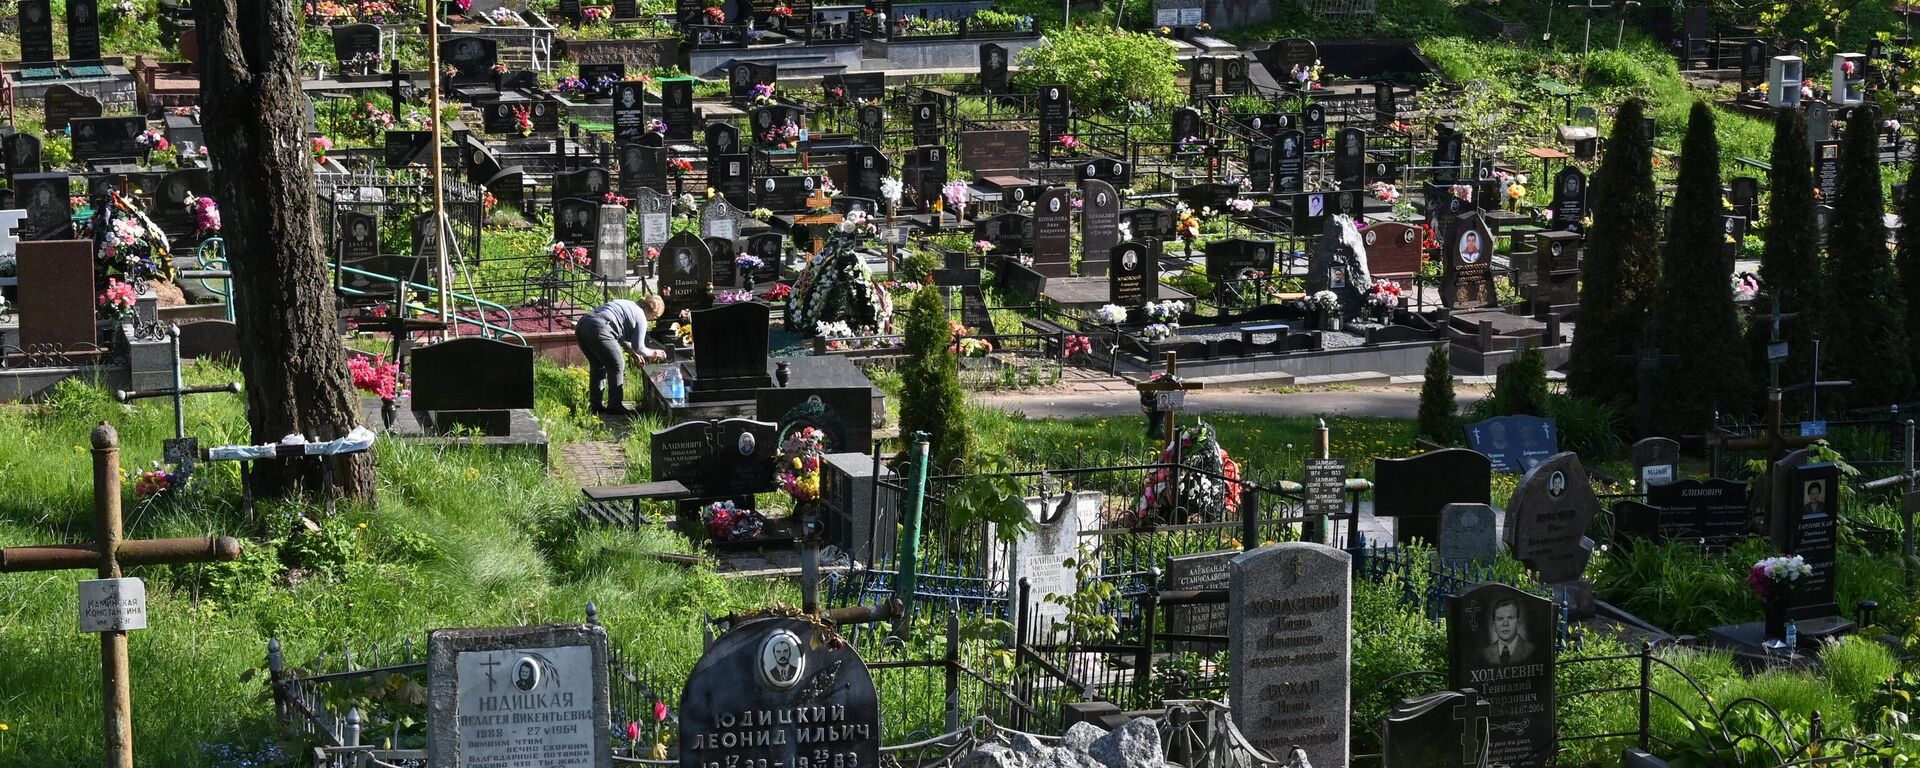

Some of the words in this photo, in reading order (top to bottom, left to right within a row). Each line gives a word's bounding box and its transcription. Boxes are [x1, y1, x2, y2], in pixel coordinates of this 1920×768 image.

[1681, 488, 1722, 497] КЛИМОВИЧ
[1470, 664, 1544, 683] ХОДАСЕВИЧ
[1482, 680, 1531, 695] Геннадий
[478, 692, 574, 712] ЮДИЦКАЯ
[461, 713, 509, 727] ПЕЛАГЕЯ
[512, 710, 594, 725] ВИКЕНТЬЕВНА
[715, 703, 845, 729] ЮДИЦКИЙ
[527, 726, 541, 736] 27
[515, 738, 543, 746] ЧТИМ
[692, 730, 787, 751] ЛЕОНИД
[796, 724, 870, 744] ИЛЬИЧ
[506, 745, 539, 753] ВЕЧНО
[543, 743, 588, 752] СКОРБИМ
[543, 750, 590, 758] ПОТОМКИ
[513, 760, 531, 768] ЧТО
